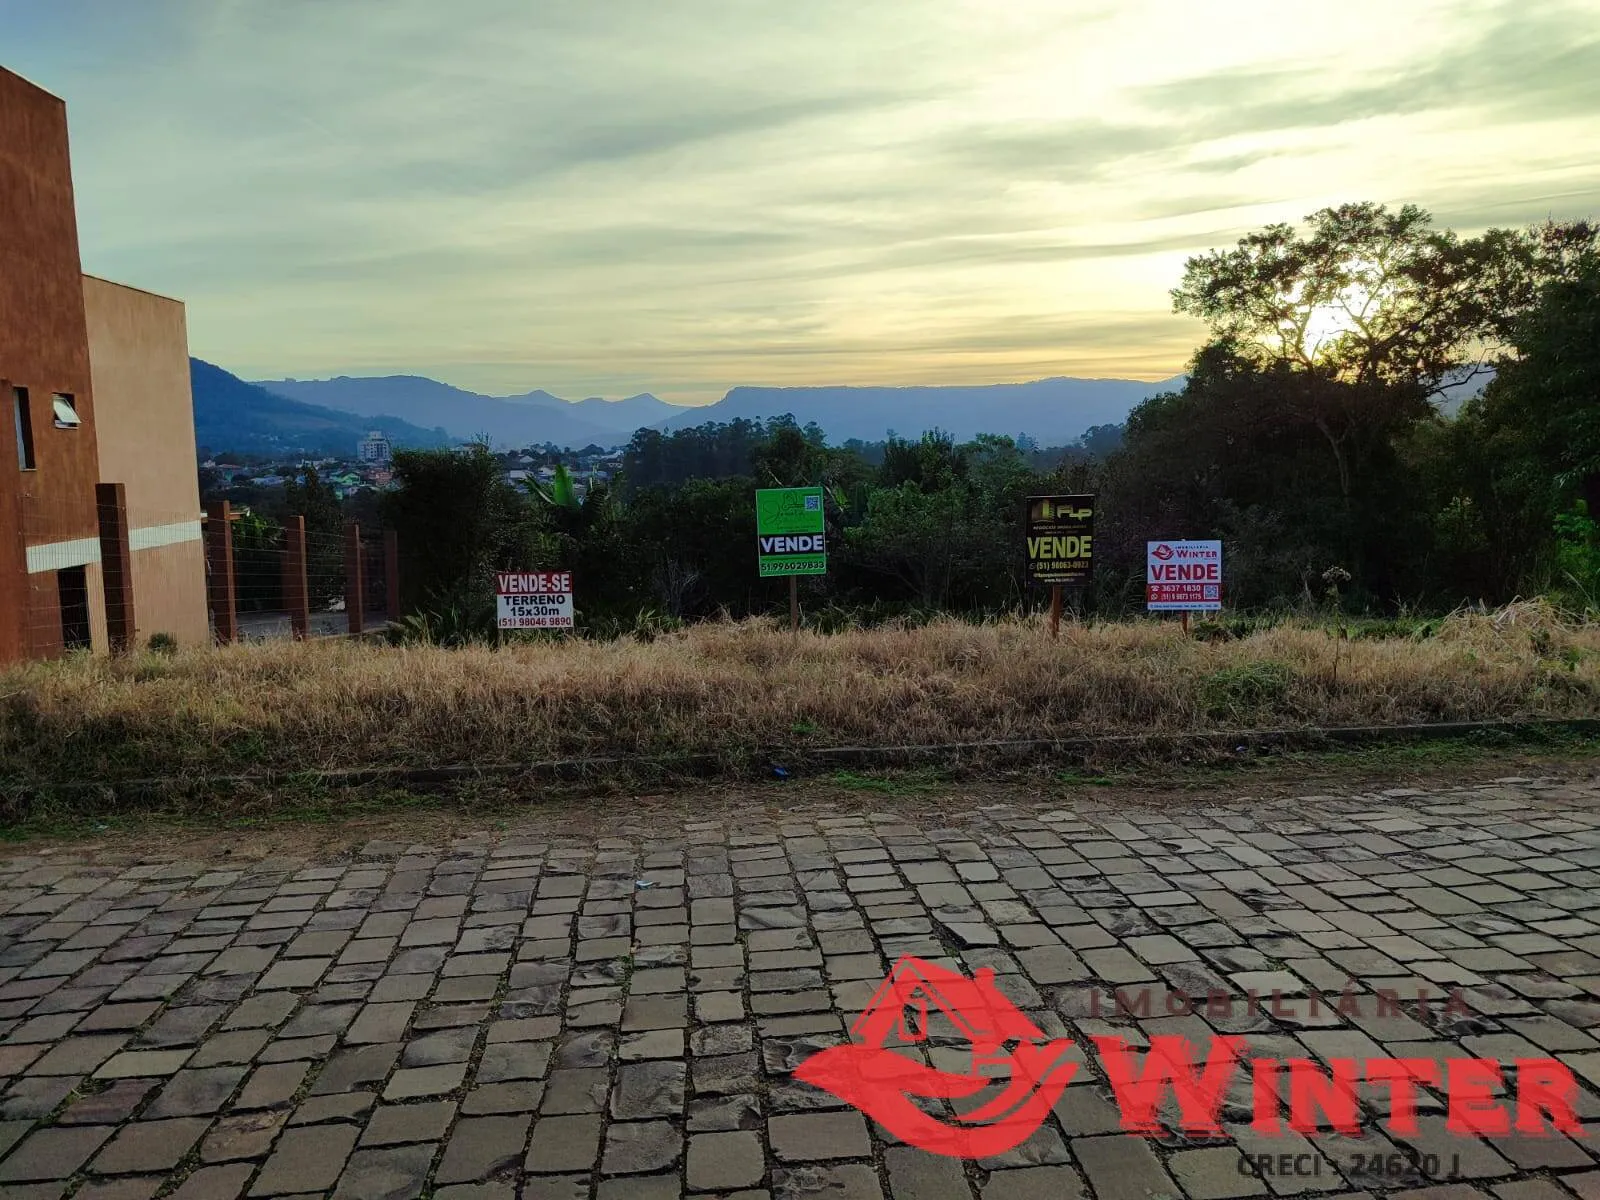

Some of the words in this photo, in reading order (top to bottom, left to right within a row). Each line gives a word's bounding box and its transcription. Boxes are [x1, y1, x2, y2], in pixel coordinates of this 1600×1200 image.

[760, 535, 823, 553] VENDE
[1027, 535, 1092, 559] VENDE
[1176, 550, 1217, 558] WINTER
[1036, 561, 1050, 571] (51)
[1151, 564, 1218, 580] VENDE
[498, 574, 570, 593] VENDE-SE
[504, 595, 565, 606] TERRENO
[510, 606, 560, 617] 15x30m
[498, 617, 517, 627] (51)
[519, 617, 547, 626] 98046
[549, 616, 571, 626] 9890
